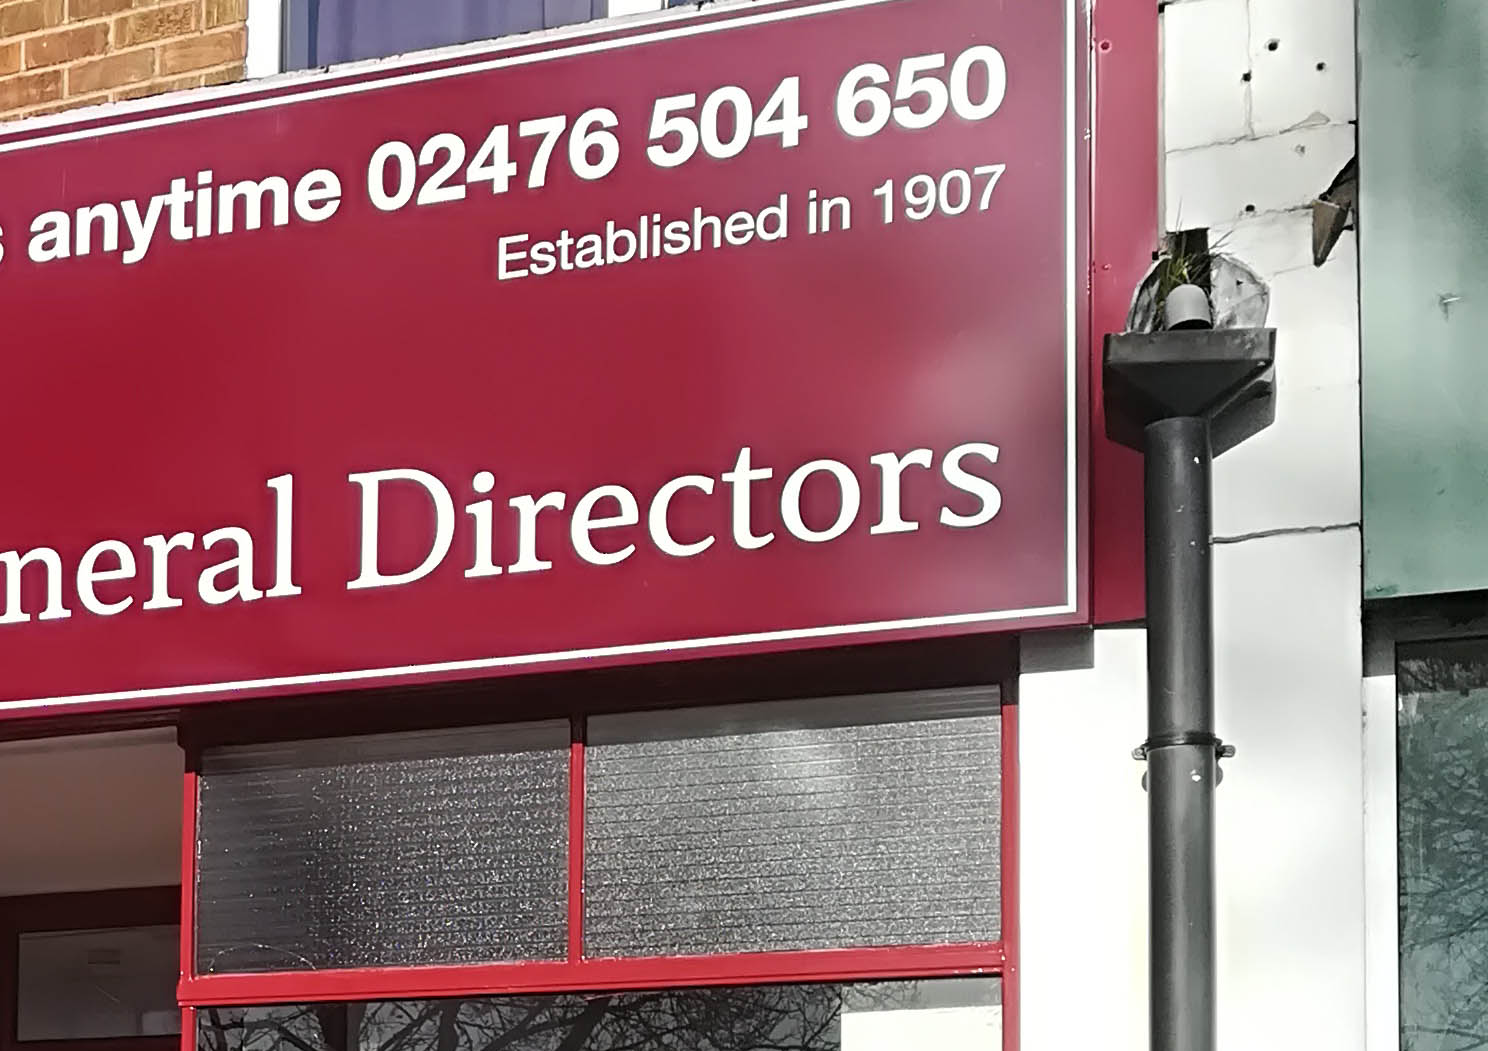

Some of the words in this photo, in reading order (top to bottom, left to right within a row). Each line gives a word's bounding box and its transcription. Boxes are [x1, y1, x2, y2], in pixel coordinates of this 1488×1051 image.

[27, 166, 342, 265] anytime
[367, 106, 620, 212] 02476
[646, 76, 809, 168] 504
[835, 44, 1008, 139] 650
[497, 194, 788, 281] Established
[807, 190, 851, 233] in
[873, 163, 1007, 225] 1907
[346, 441, 1004, 590] Directors
